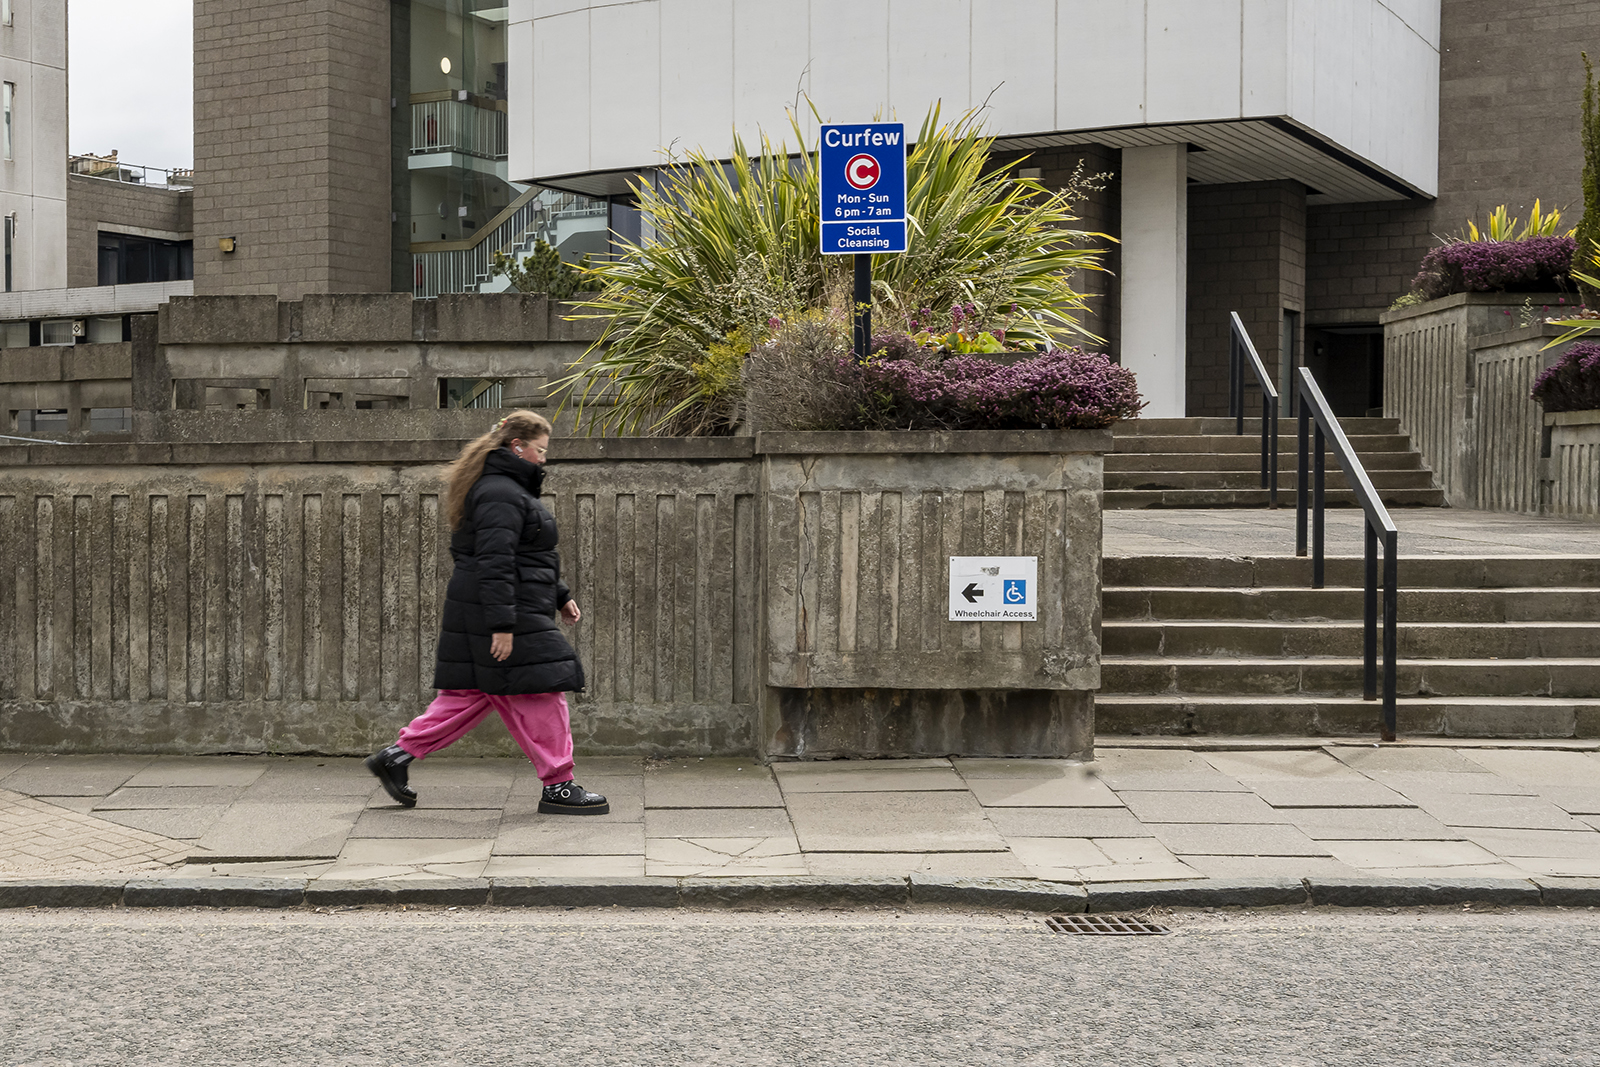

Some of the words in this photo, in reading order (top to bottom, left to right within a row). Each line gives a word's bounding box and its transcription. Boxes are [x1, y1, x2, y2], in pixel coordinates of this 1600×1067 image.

[825, 128, 900, 147] Curfew
[849, 158, 874, 186] C
[838, 194, 861, 203] Mon
[868, 193, 889, 202] Sun
[847, 226, 880, 235] Social
[838, 238, 889, 248] Cleansing
